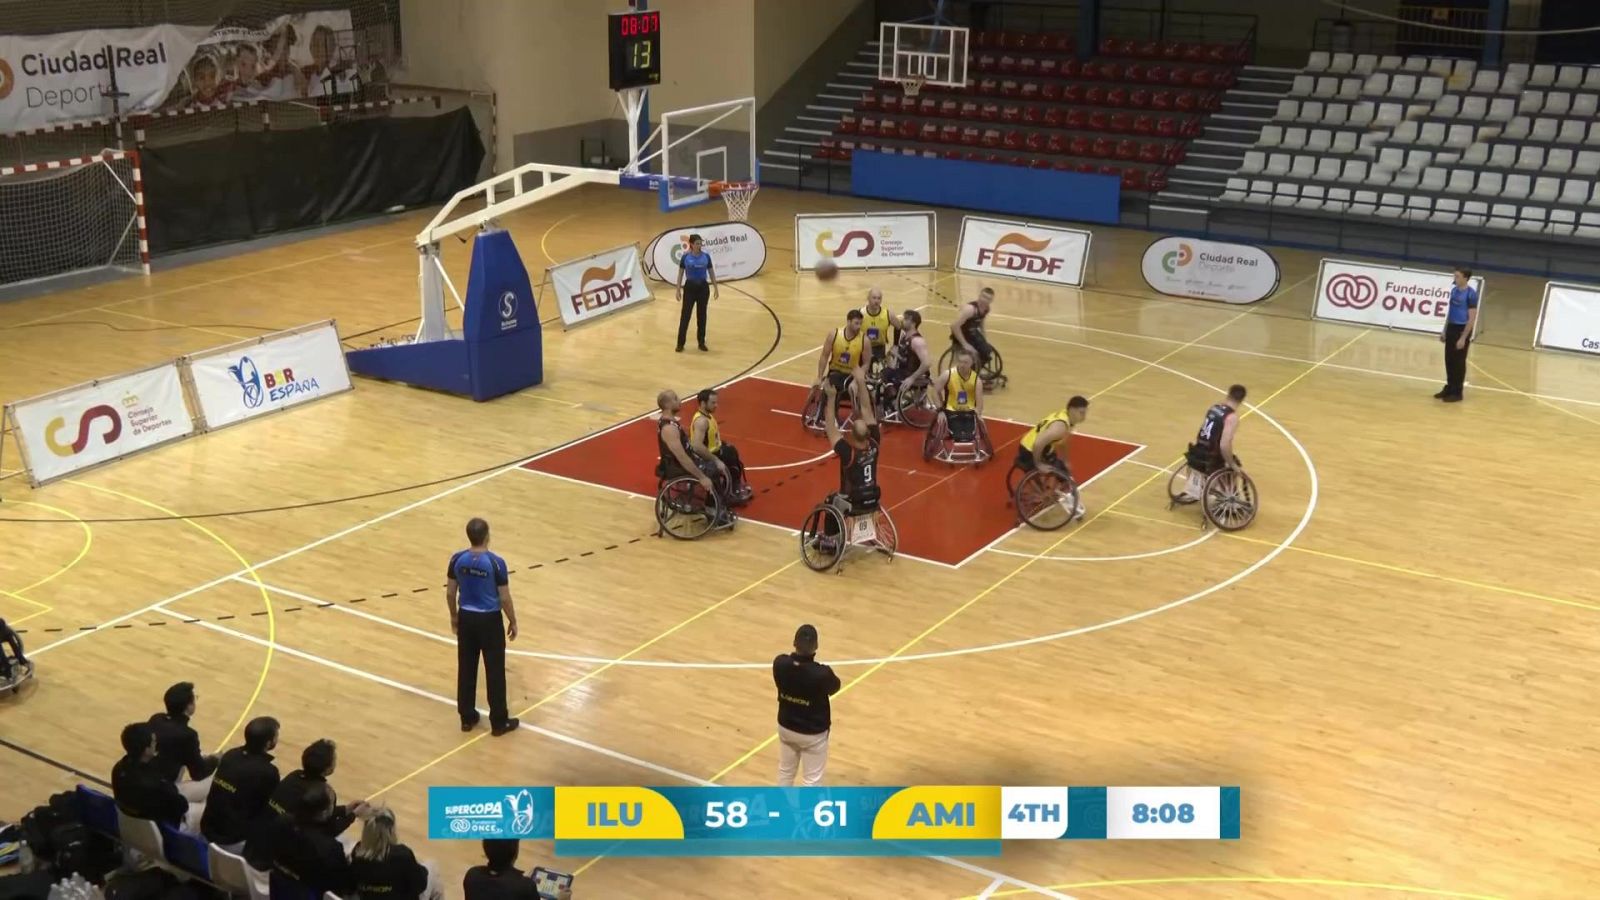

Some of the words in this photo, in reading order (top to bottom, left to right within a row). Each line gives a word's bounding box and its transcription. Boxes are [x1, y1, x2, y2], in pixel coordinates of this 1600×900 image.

[621, 15, 659, 36] 08:07
[21, 46, 109, 77] Ciudad
[116, 42, 167, 68] Real
[633, 40, 651, 69] 13
[730, 233, 748, 243] Real
[977, 248, 1065, 275] FEDDF
[1199, 252, 1234, 265] Ciudad
[1237, 255, 1258, 267] Real
[571, 277, 634, 315] FEDDF
[1385, 282, 1451, 299] Fundación
[1382, 295, 1448, 318] ONCE
[269, 376, 321, 402] ESPAÑA
[864, 464, 872, 482] 9
